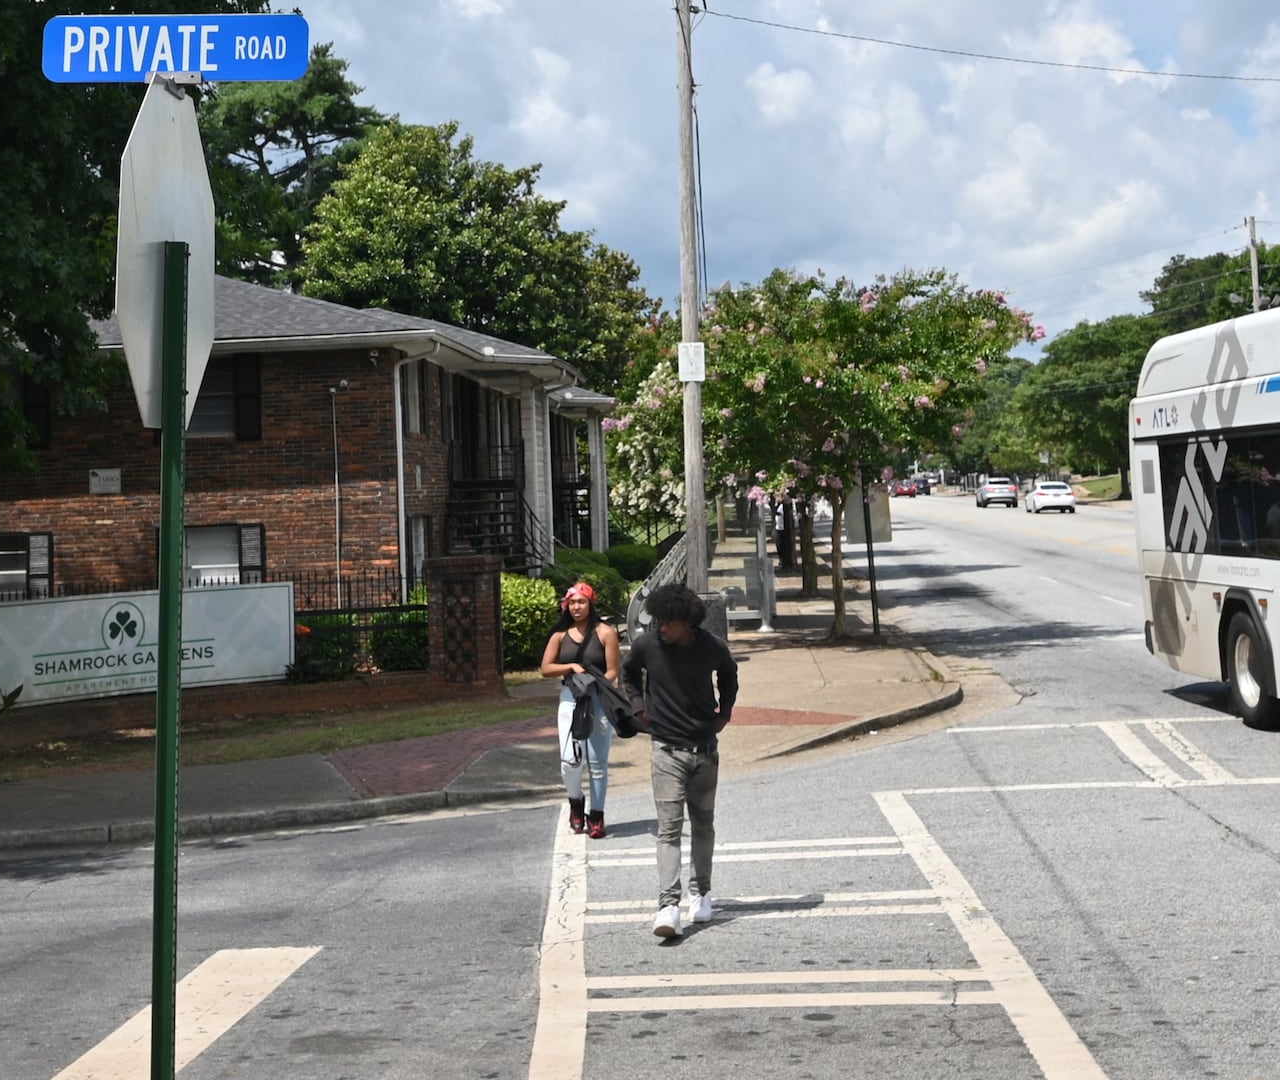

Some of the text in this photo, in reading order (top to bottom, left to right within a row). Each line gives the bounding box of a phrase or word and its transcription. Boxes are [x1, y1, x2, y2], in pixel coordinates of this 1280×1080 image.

[62, 24, 288, 73] PRIVATE ROAD
[34, 645, 214, 676] SHAMROCK GAENS
[65, 677, 137, 692] APARTMENT
